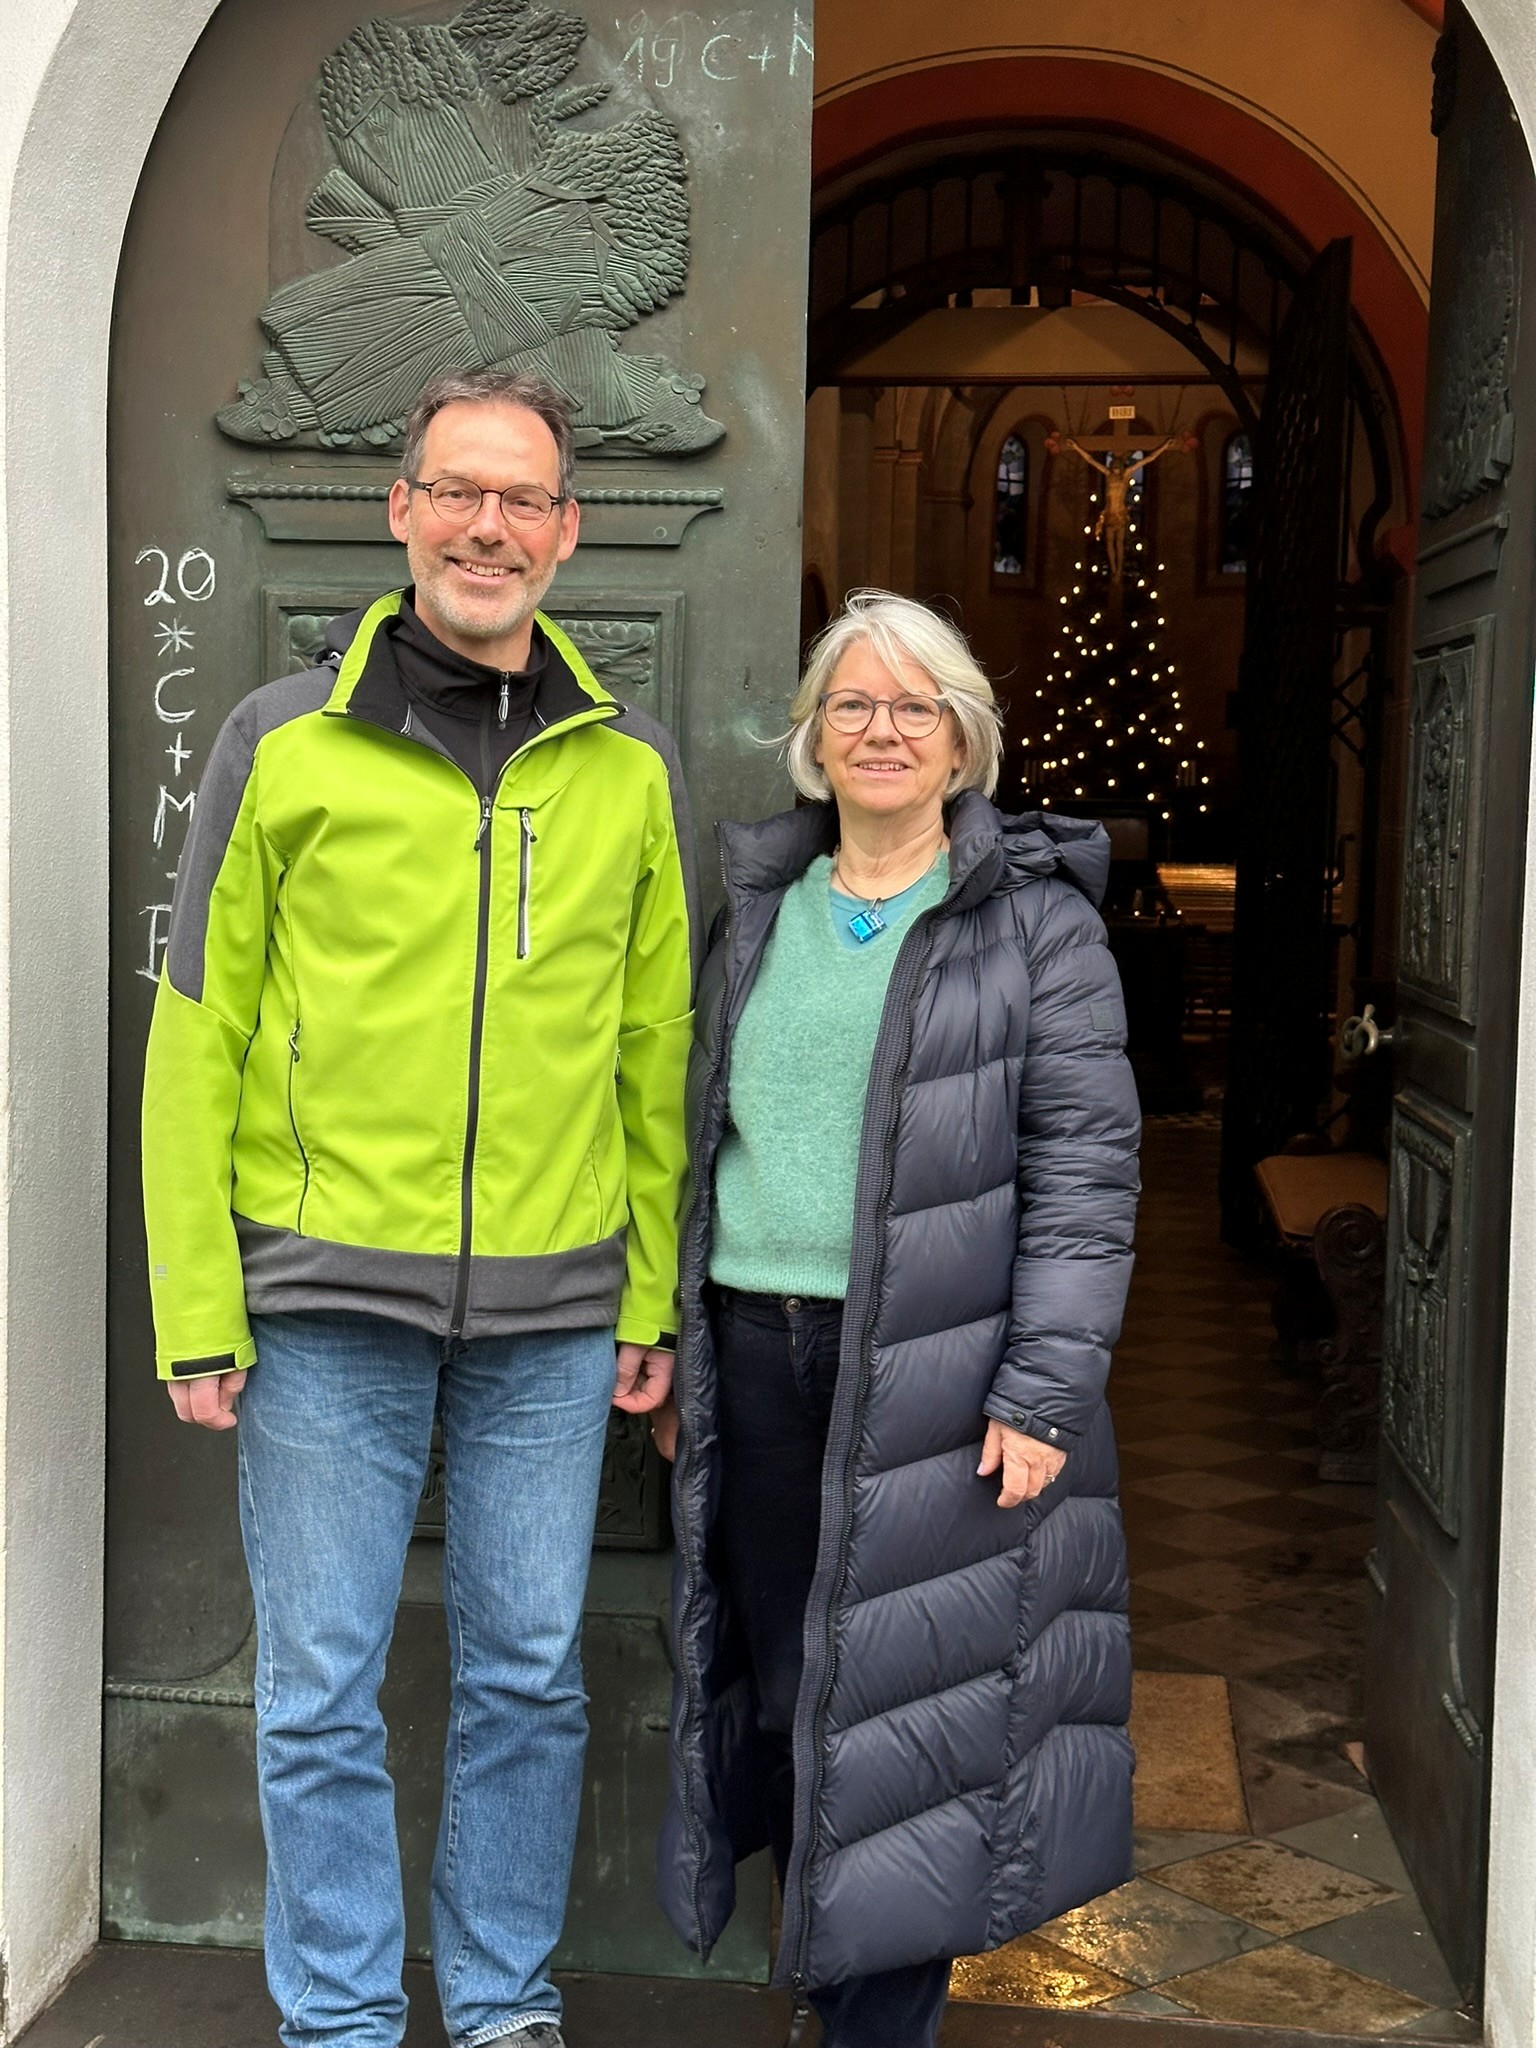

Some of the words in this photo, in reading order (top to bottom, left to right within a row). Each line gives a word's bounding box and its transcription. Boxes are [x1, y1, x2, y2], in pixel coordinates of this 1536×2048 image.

[135, 546, 216, 606] 20
[154, 666, 196, 724] C
[152, 784, 198, 850] M
